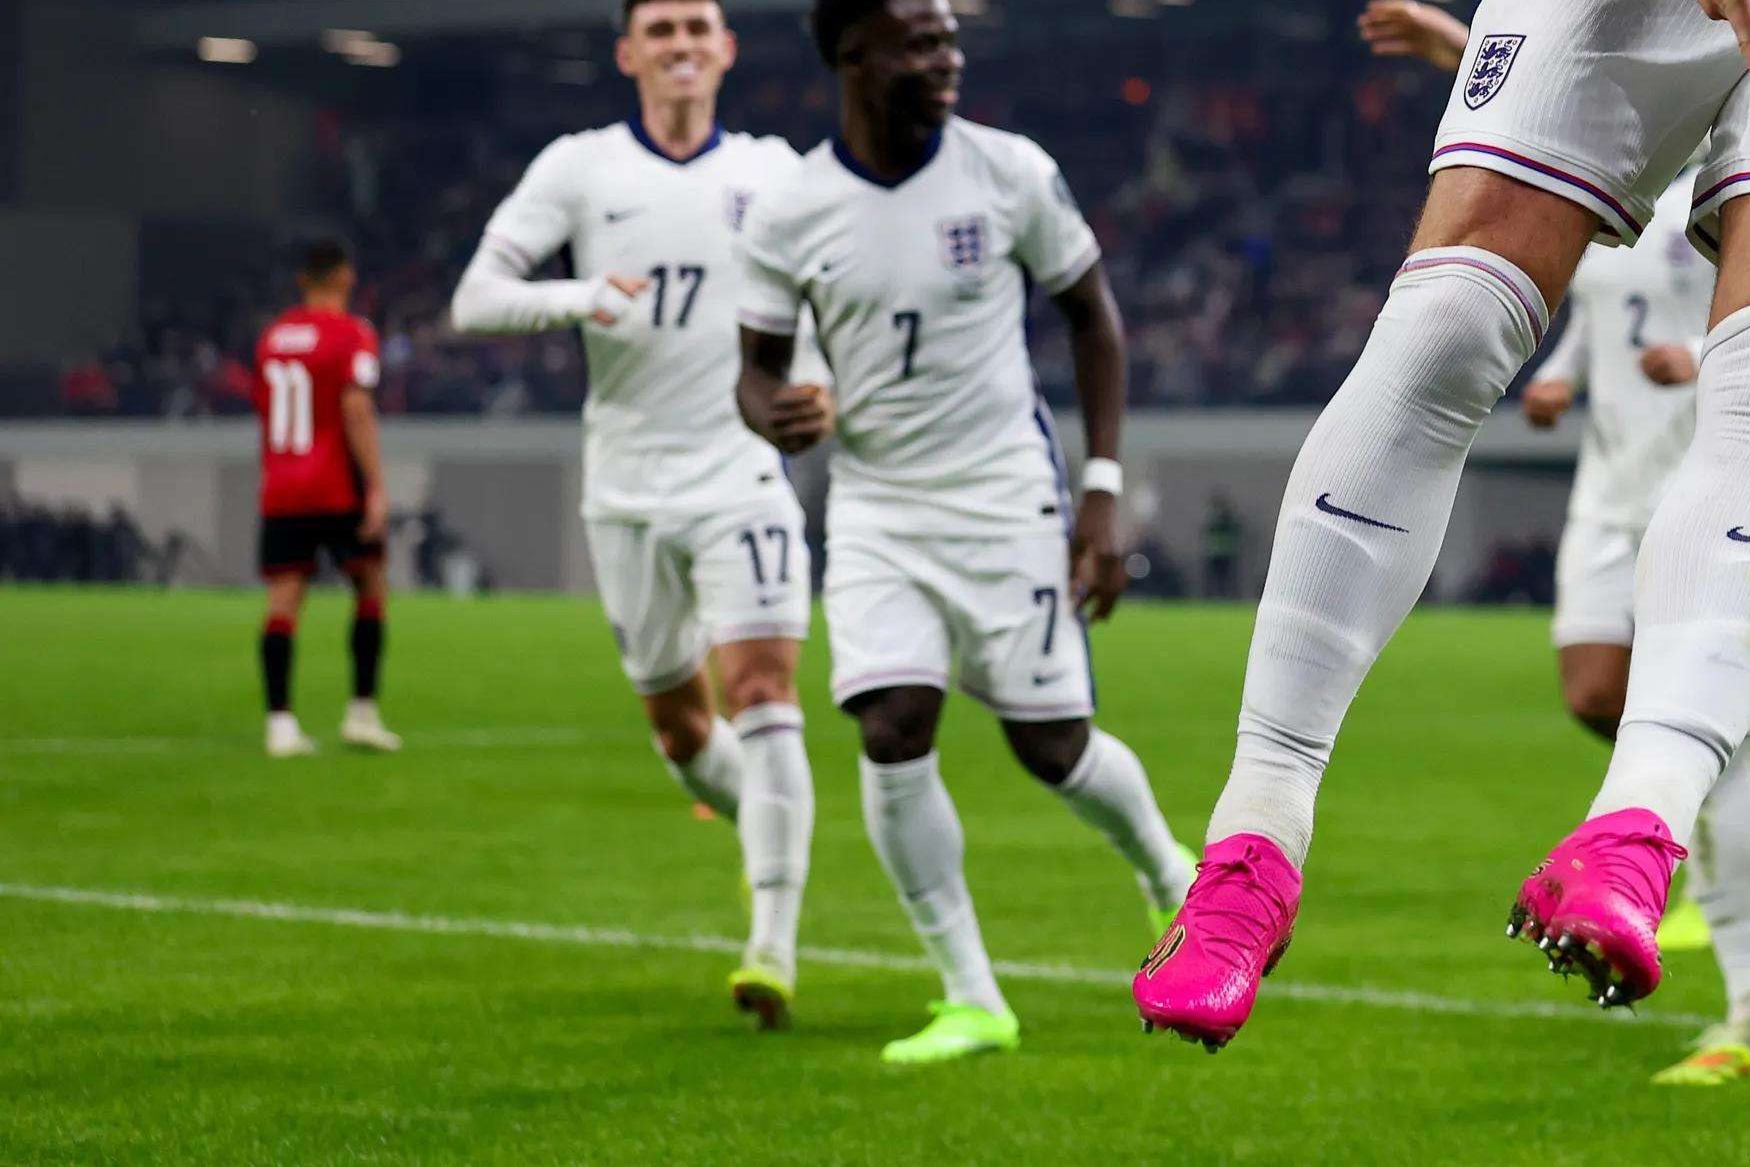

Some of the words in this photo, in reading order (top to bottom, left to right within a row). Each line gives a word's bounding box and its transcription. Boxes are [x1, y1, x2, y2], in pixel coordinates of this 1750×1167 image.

[648, 265, 705, 328] 17
[893, 310, 922, 380] 7
[263, 357, 315, 456] 11
[738, 527, 788, 585] 17
[1033, 587, 1057, 655] 7
